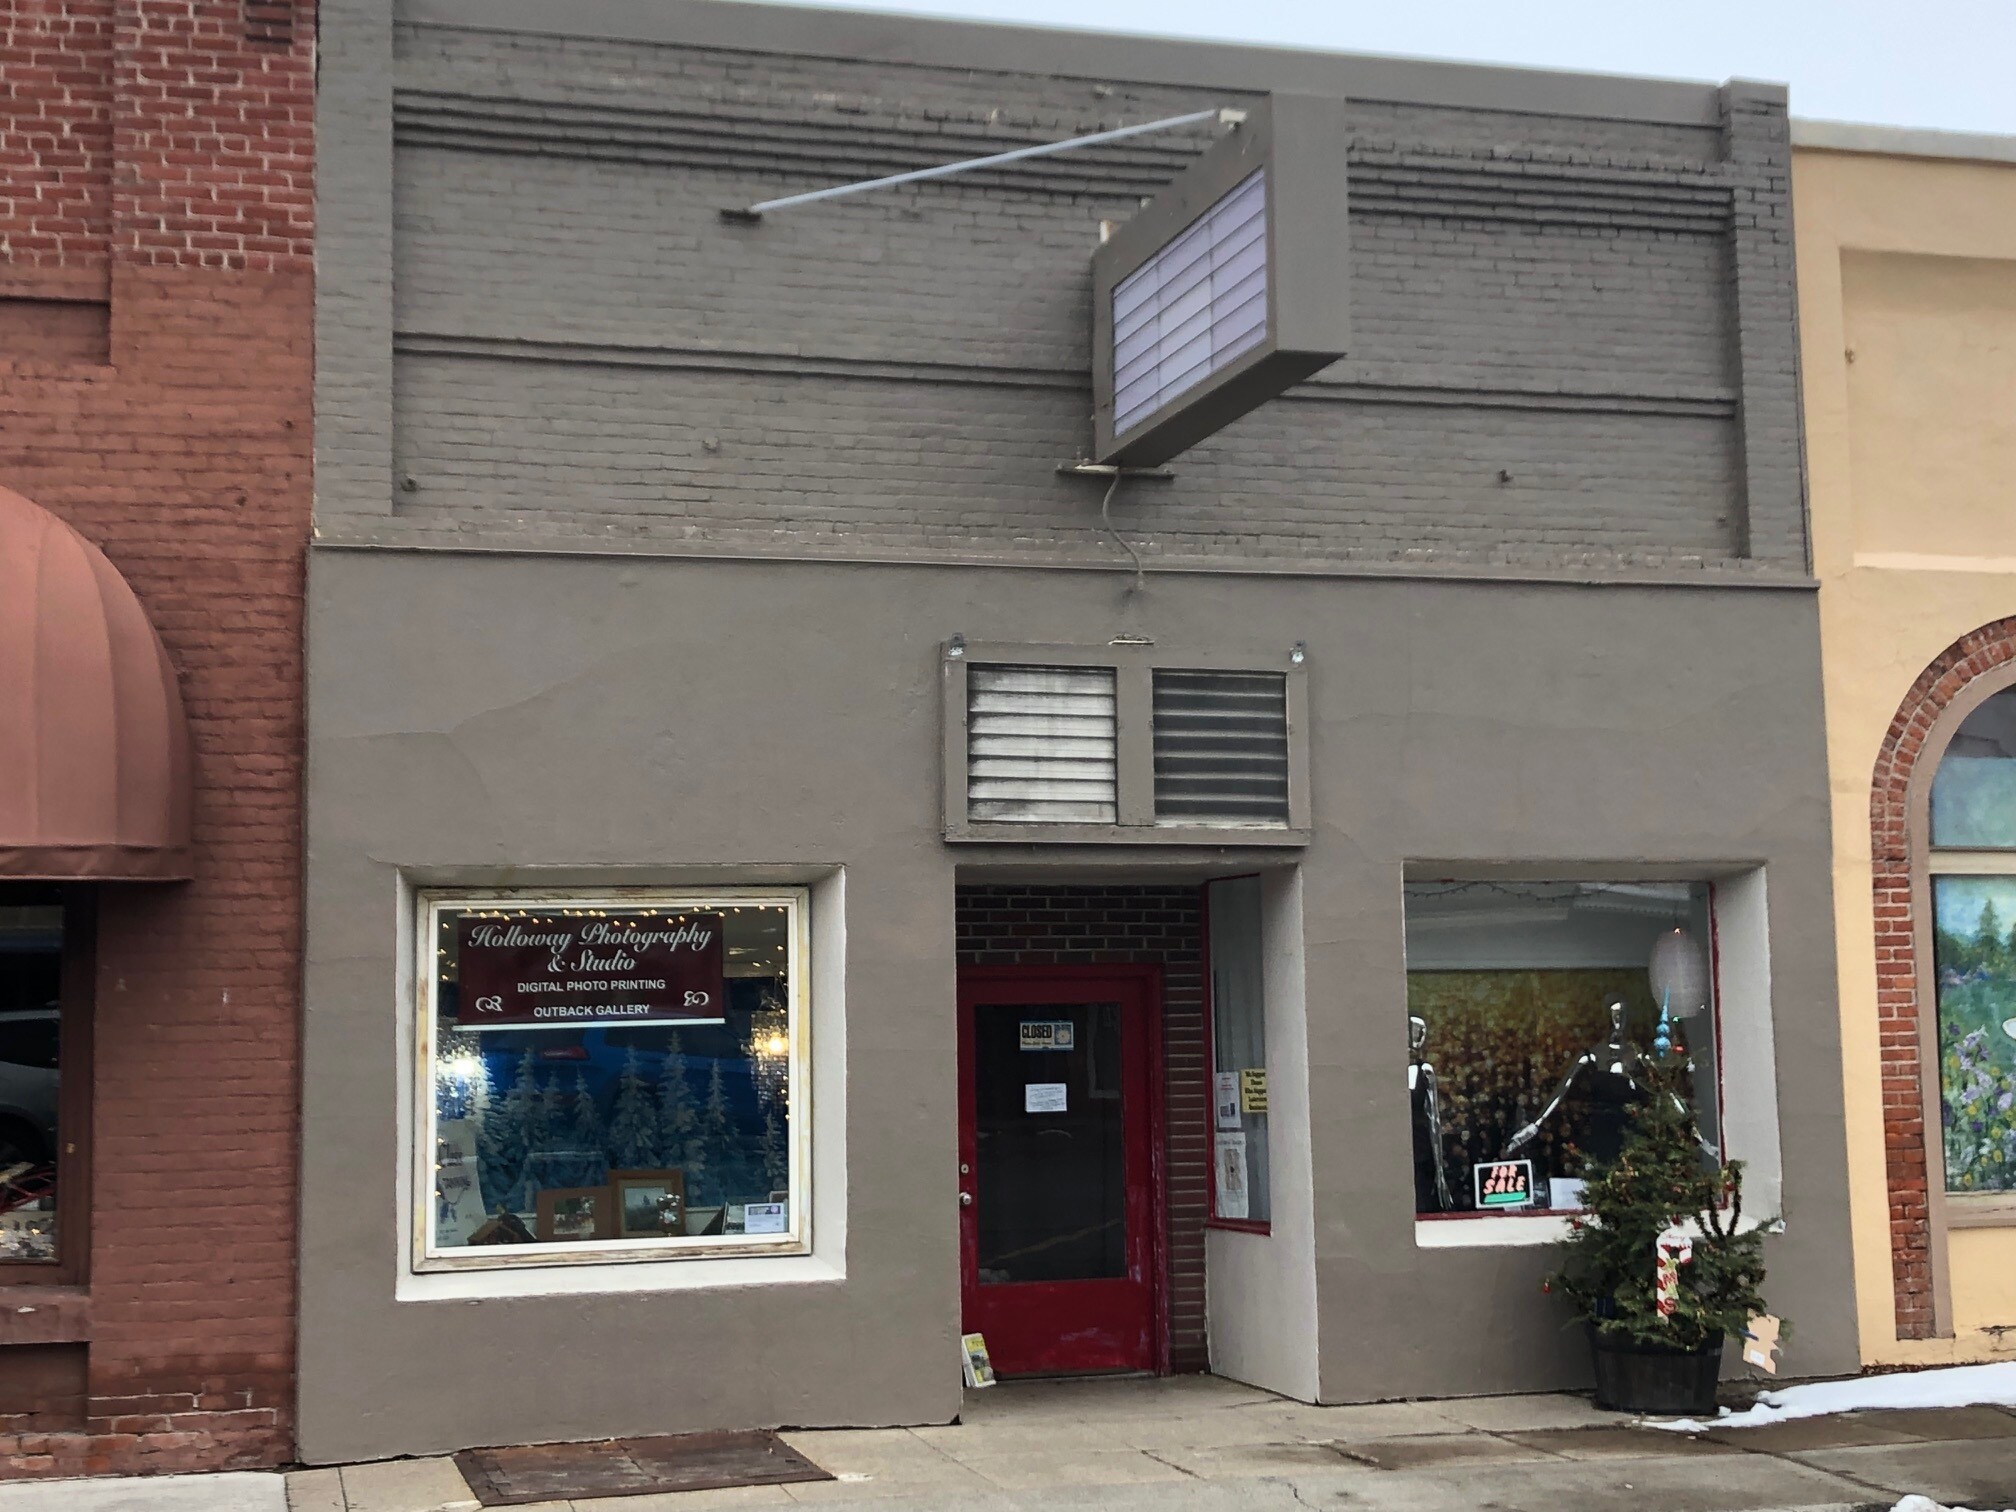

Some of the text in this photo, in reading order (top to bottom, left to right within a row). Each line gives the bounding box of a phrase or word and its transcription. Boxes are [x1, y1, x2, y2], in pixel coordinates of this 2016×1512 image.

[468, 922, 712, 954] Holloway Photography
[547, 949, 636, 972] & Studio
[517, 979, 666, 993] DIGITAL PHOTO PRINTING
[533, 1003, 650, 1017] OUTBACK GALLERY
[1022, 1024, 1052, 1038] CLOSED
[1490, 1164, 1517, 1179] FOR
[1483, 1175, 1526, 1194] SALE
